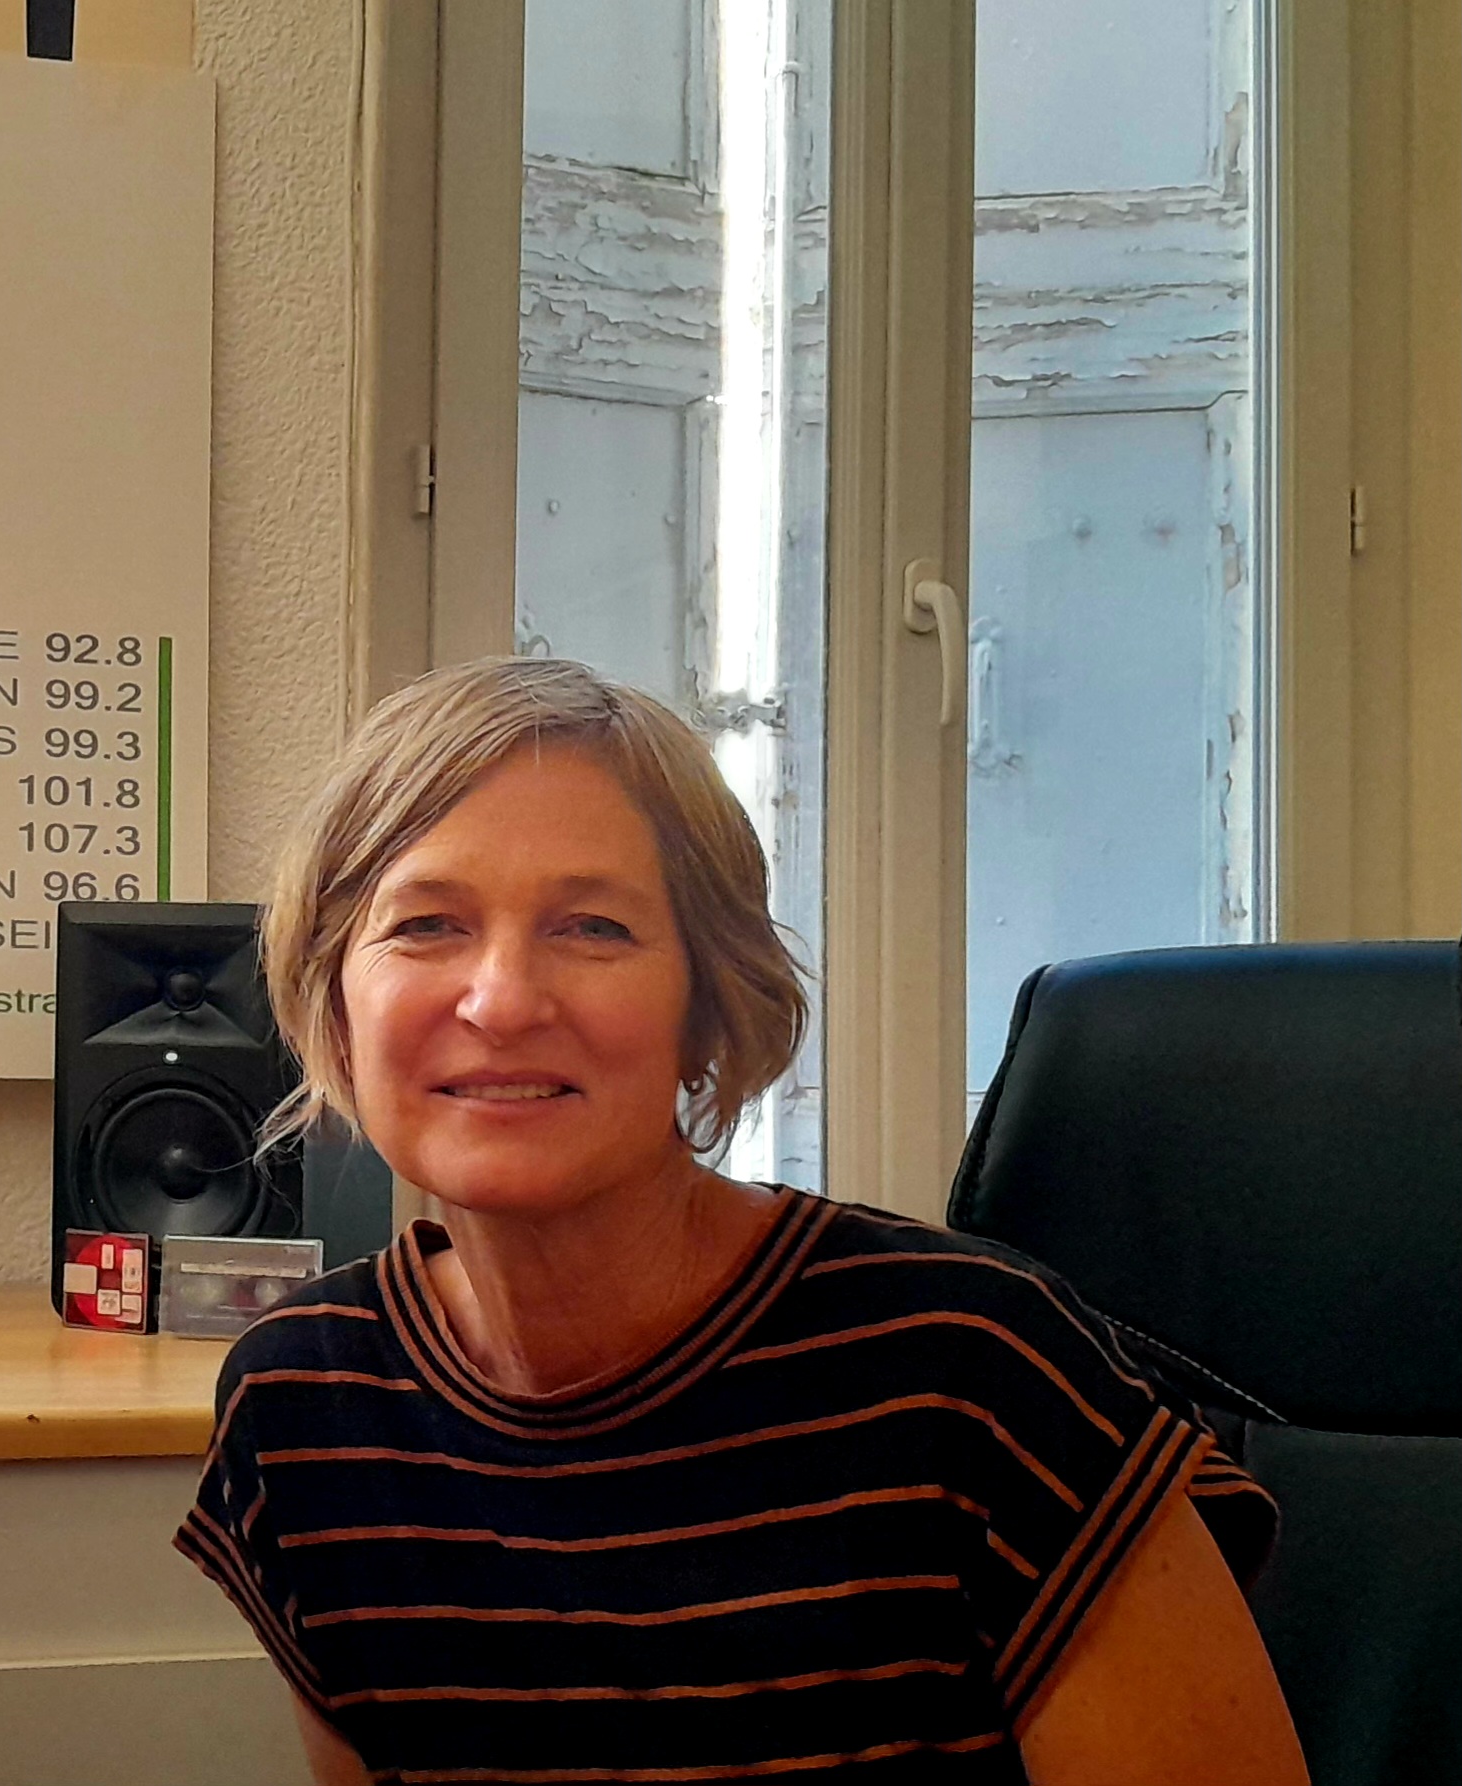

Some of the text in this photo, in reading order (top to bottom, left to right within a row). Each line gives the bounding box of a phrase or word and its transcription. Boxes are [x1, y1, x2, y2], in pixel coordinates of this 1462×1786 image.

[45, 633, 142, 667] 92.8
[45, 680, 142, 713] 99.2
[45, 729, 141, 761] 99.3
[19, 776, 141, 808] 101.8
[19, 823, 141, 856] 107.3
[43, 871, 140, 901] 96.6
